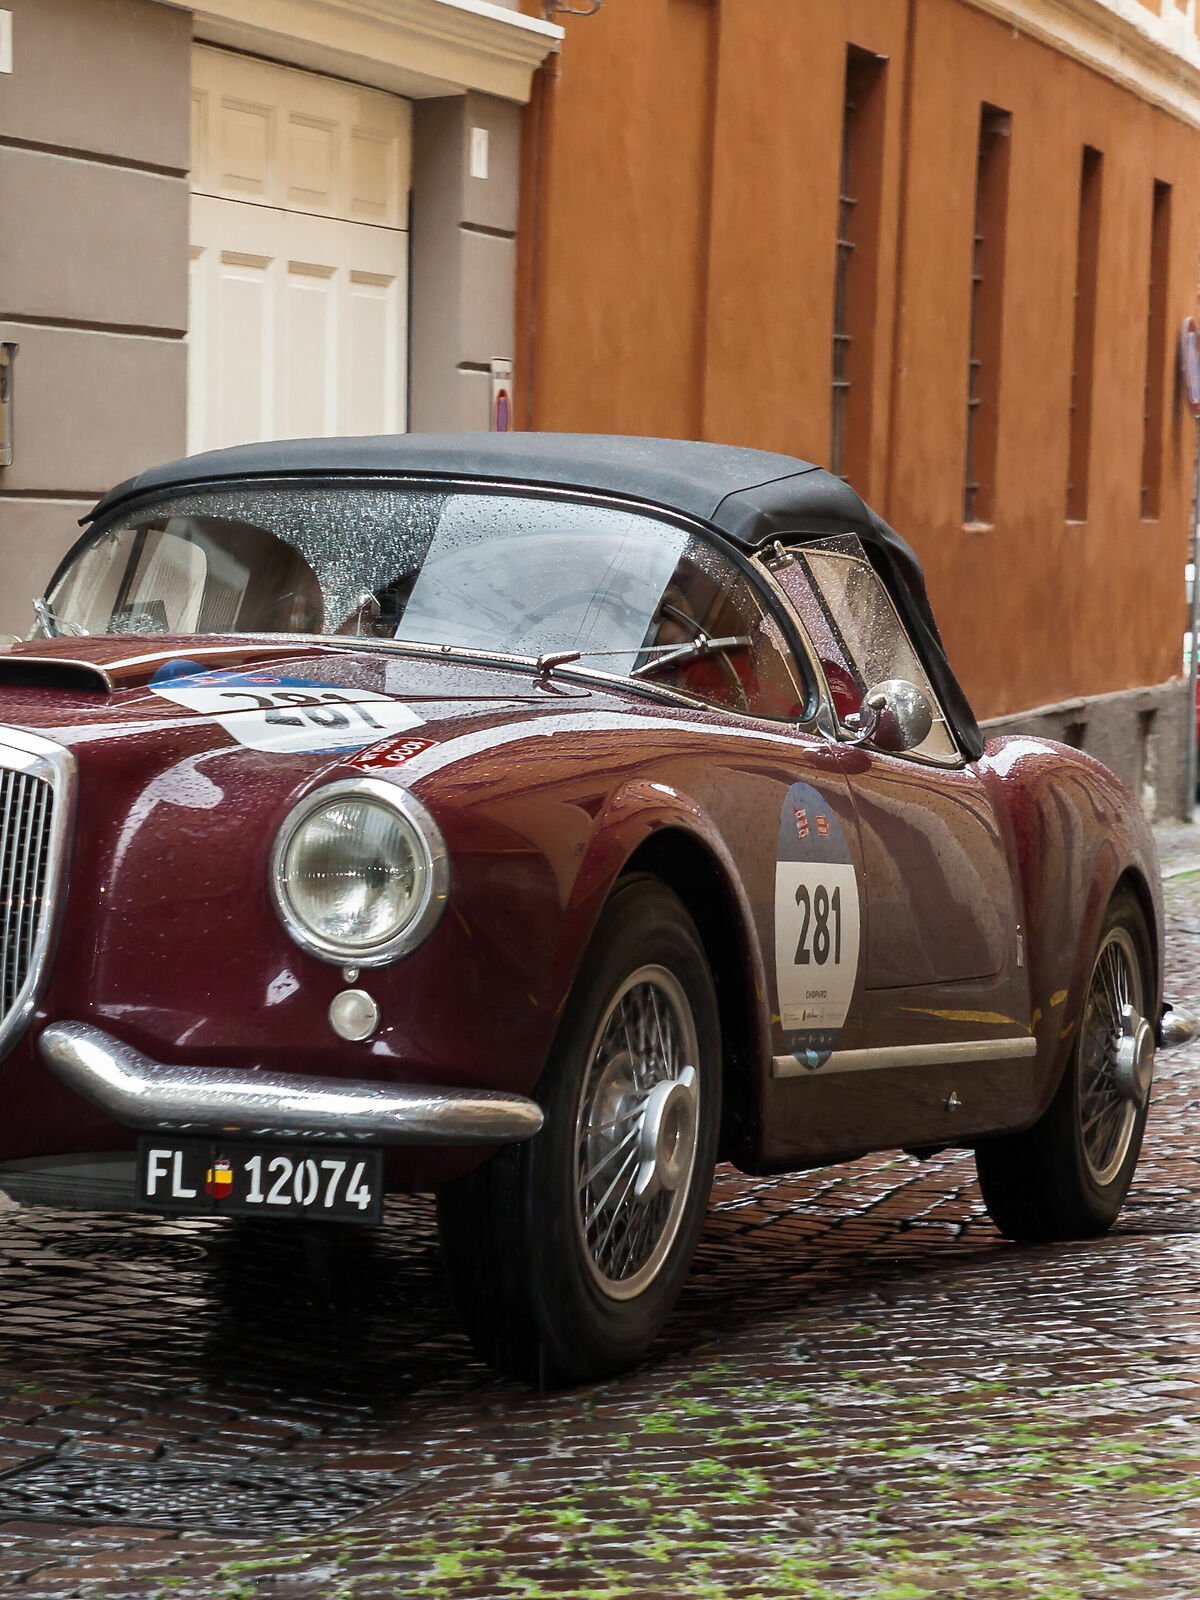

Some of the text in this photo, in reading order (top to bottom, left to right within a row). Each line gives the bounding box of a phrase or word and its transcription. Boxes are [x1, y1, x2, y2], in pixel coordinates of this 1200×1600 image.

[220, 691, 388, 729] 281
[385, 741, 426, 761] 1000
[794, 884, 841, 965] 281
[146, 1150, 371, 1210] FL 12074
